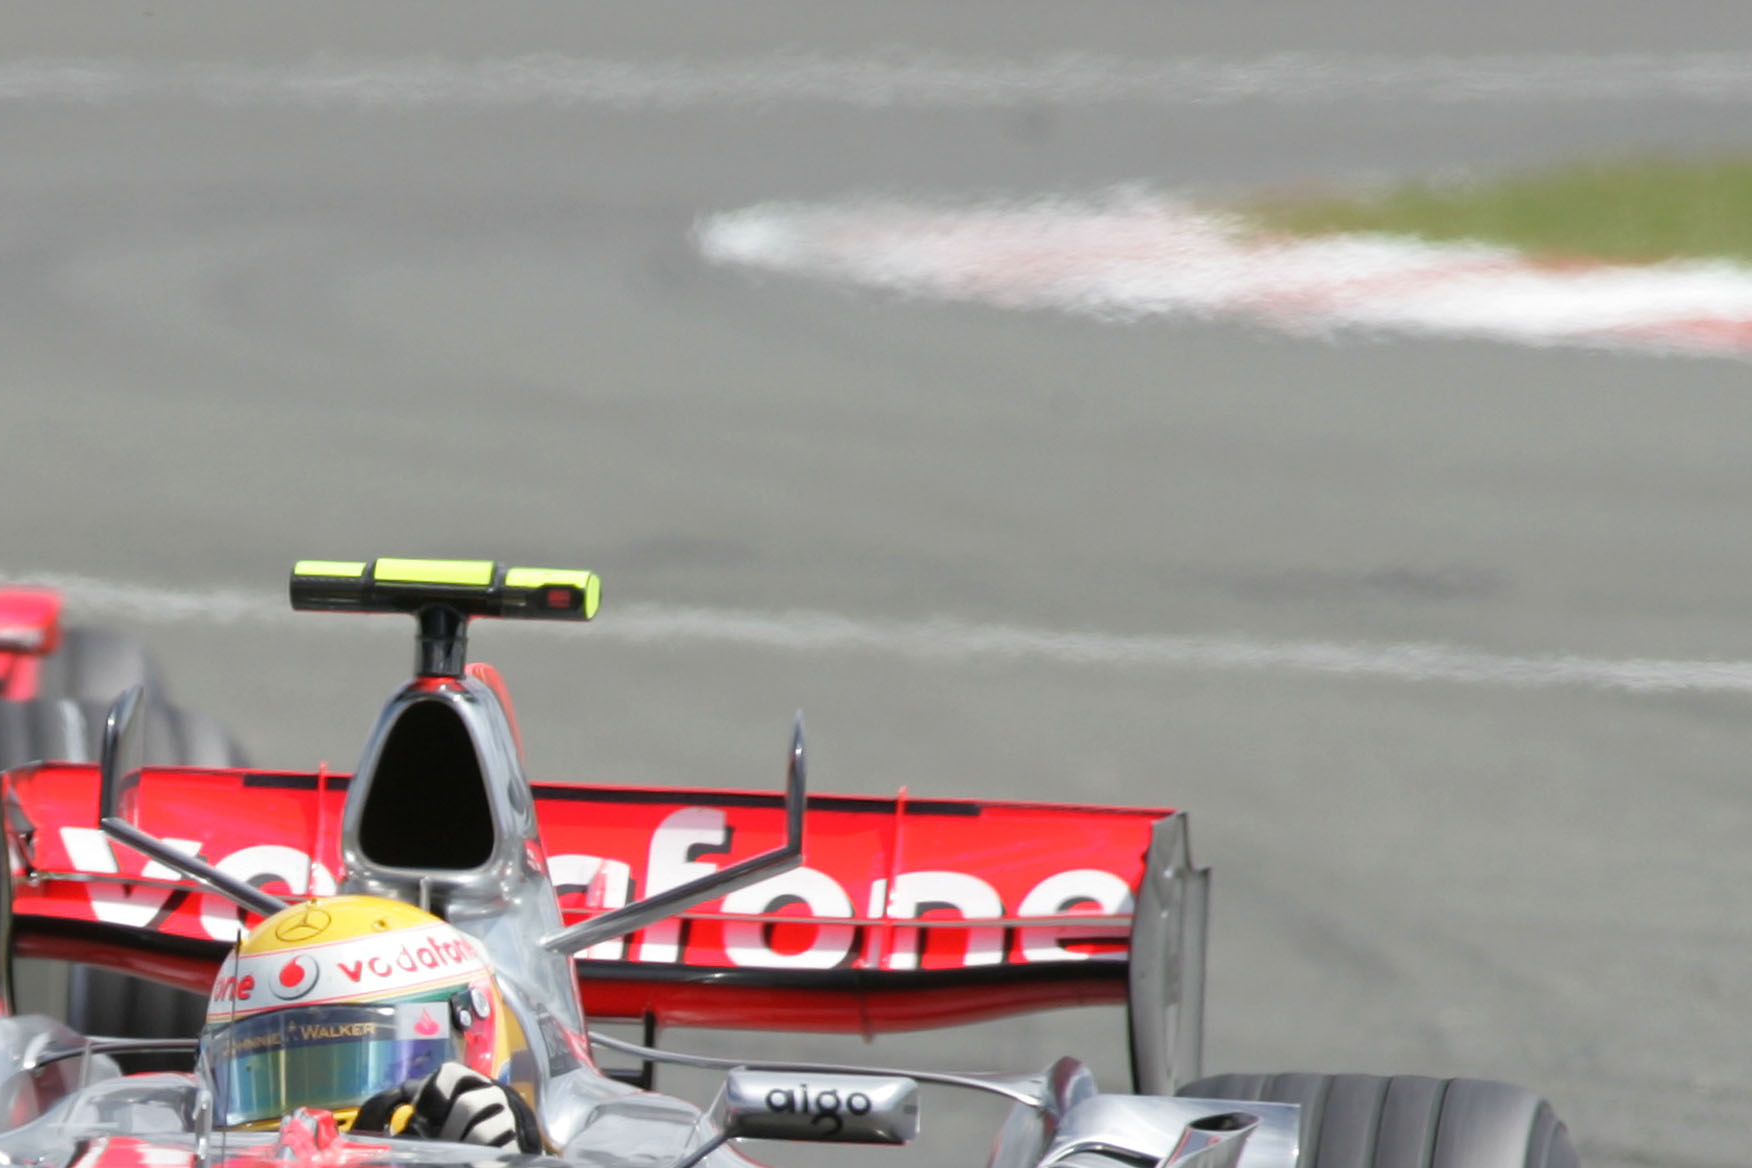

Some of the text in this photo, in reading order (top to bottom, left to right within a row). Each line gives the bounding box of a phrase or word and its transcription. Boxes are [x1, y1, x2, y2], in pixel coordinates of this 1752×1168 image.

[59, 806, 1136, 970] voafone
[300, 1022, 377, 1040] WALKER
[765, 1083, 872, 1135] aigo
